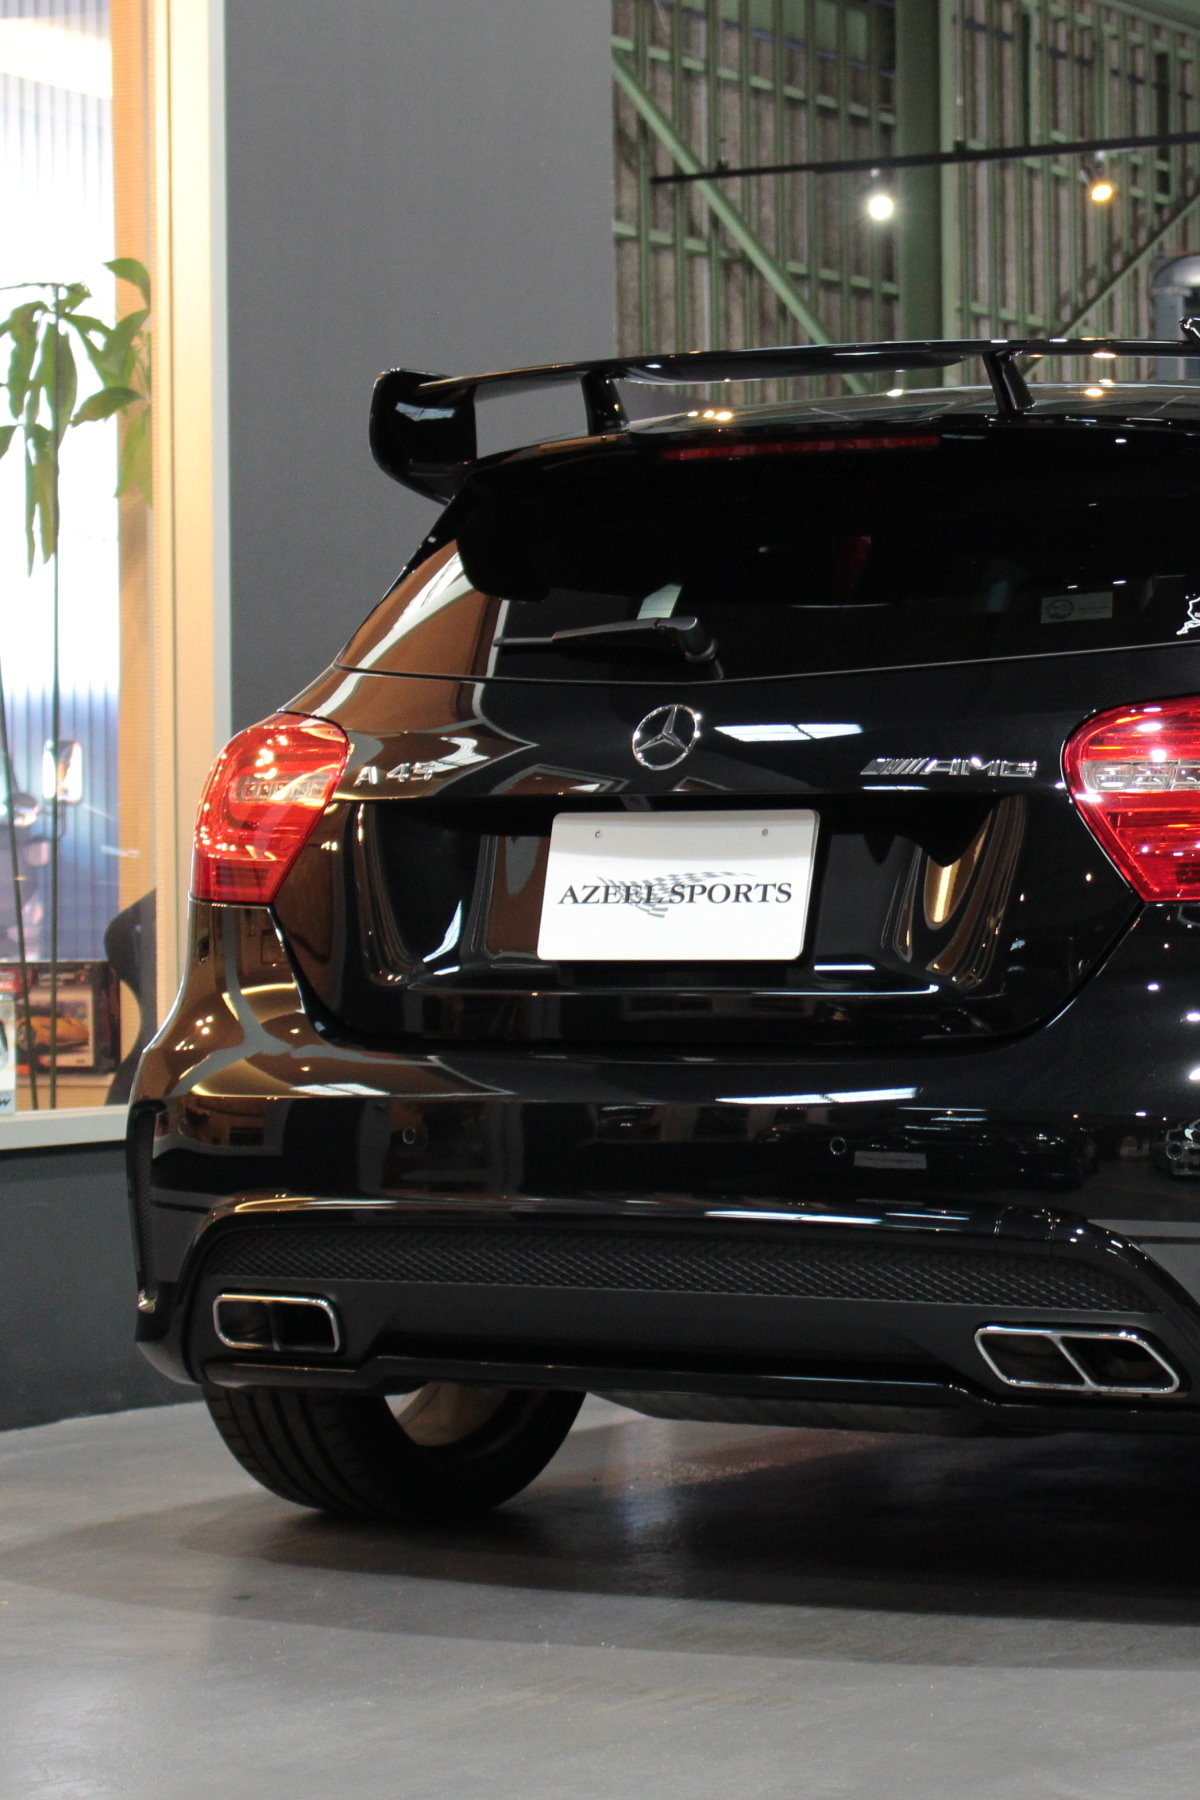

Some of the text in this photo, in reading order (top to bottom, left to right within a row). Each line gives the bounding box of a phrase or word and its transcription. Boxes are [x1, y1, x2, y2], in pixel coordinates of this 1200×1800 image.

[353, 762, 435, 787] A 45
[558, 882, 793, 905] AZEEL SPORTS
